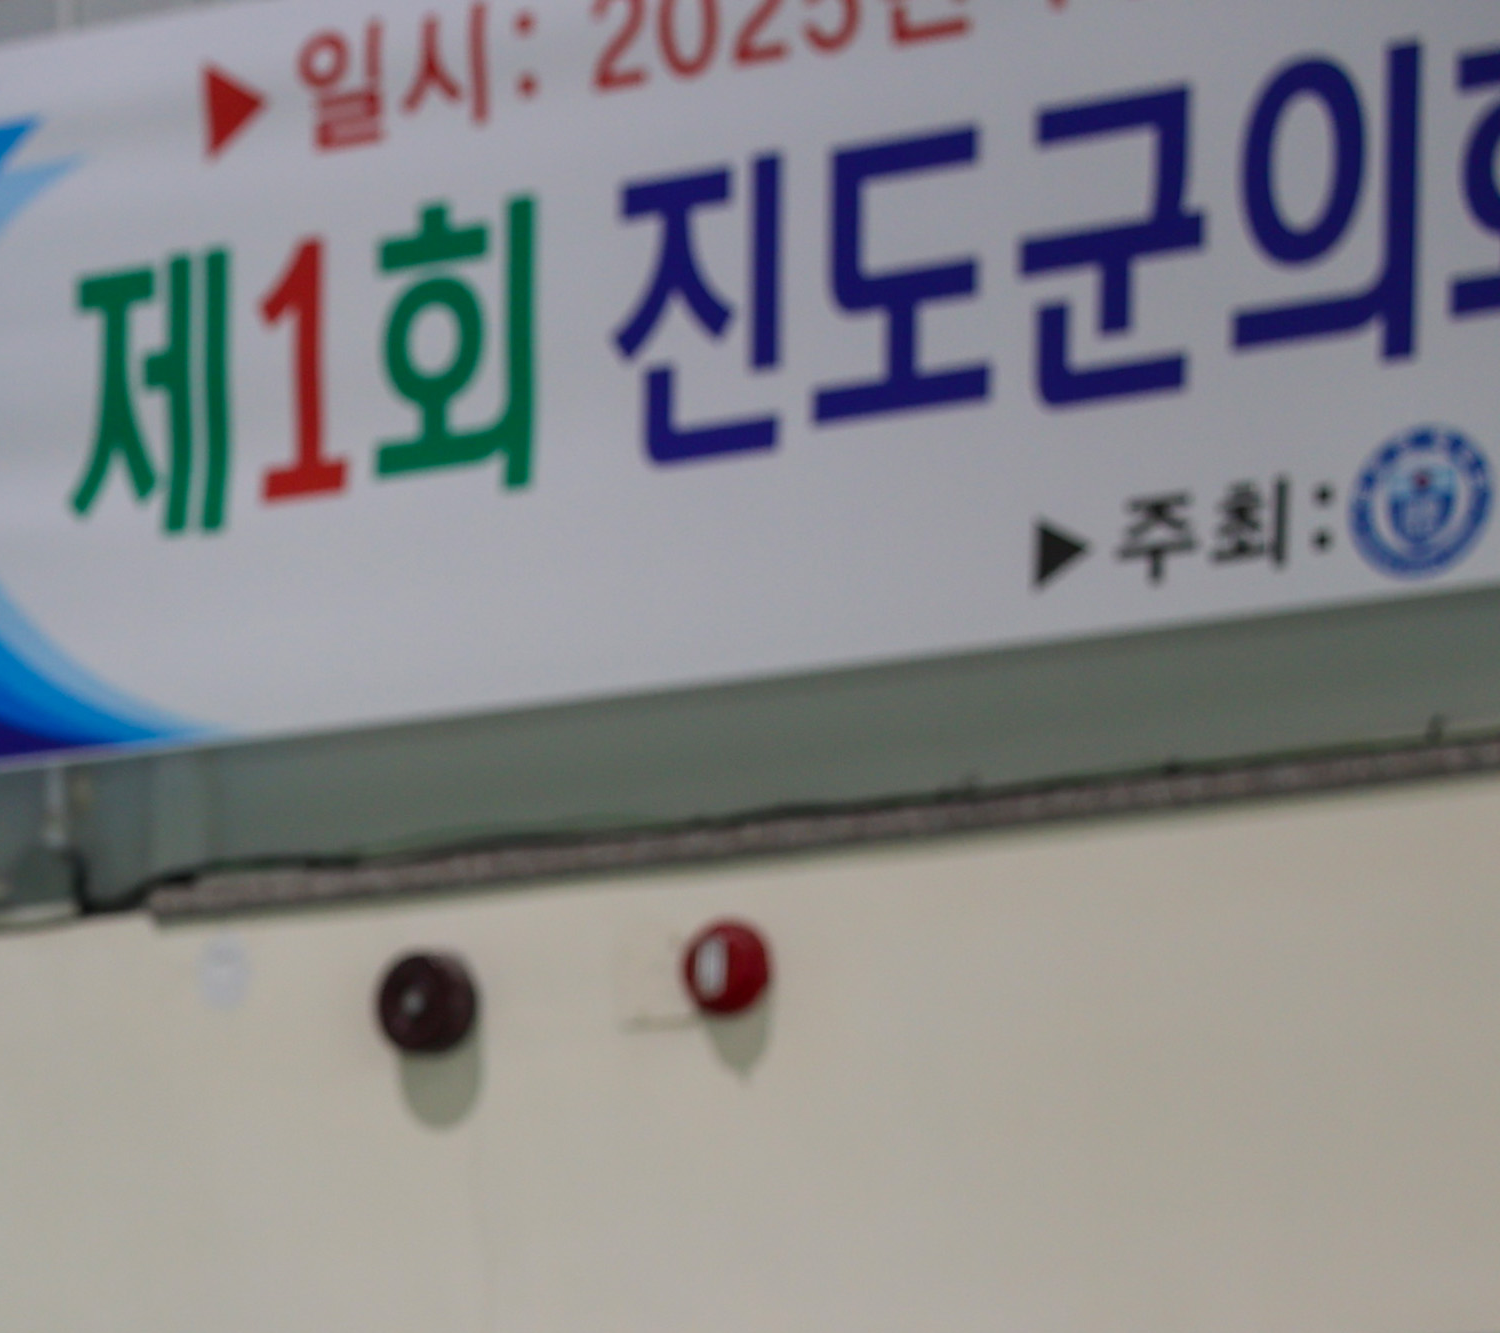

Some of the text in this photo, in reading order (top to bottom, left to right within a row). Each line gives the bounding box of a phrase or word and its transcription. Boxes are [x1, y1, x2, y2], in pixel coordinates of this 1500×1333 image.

[299, 3, 537, 152] 일시:
[67, 193, 540, 537] 제1회
[1118, 475, 1334, 586] 주최:
